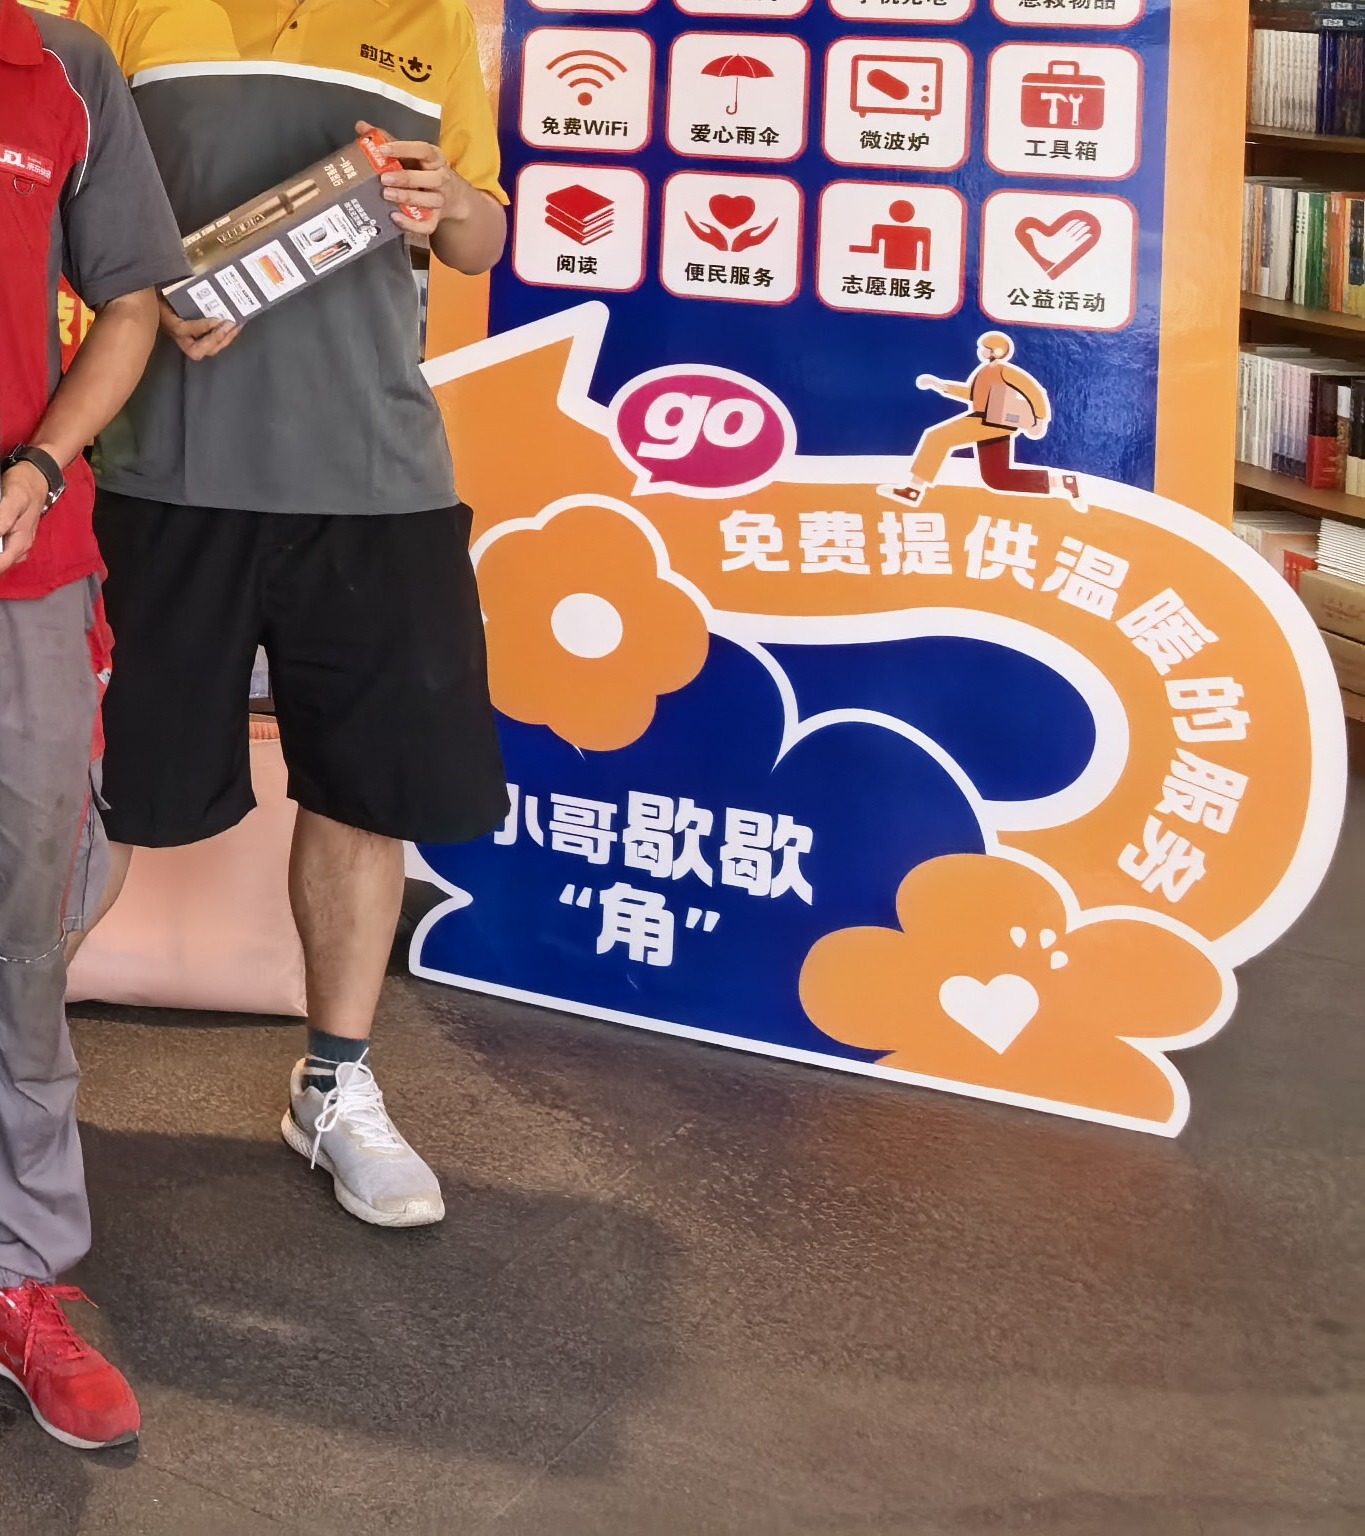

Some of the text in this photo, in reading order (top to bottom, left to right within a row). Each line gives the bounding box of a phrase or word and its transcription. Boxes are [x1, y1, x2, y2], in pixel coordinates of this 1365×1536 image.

[540, 116, 629, 139] 免费WiFi
[690, 123, 780, 147] 爱心雨伞
[859, 129, 931, 153] 微波炉
[1024, 139, 1099, 164] 工具箱
[555, 253, 598, 276] 阅读
[684, 261, 775, 288] 便民服务
[841, 273, 936, 300] 志愿服务
[1007, 286, 1106, 314] 公益活动
[635, 387, 766, 462] go
[718, 510, 1251, 906] 免费提供温暖的服务
[493, 781, 815, 908] 小哥歇歇
[559, 884, 722, 967] “角”
